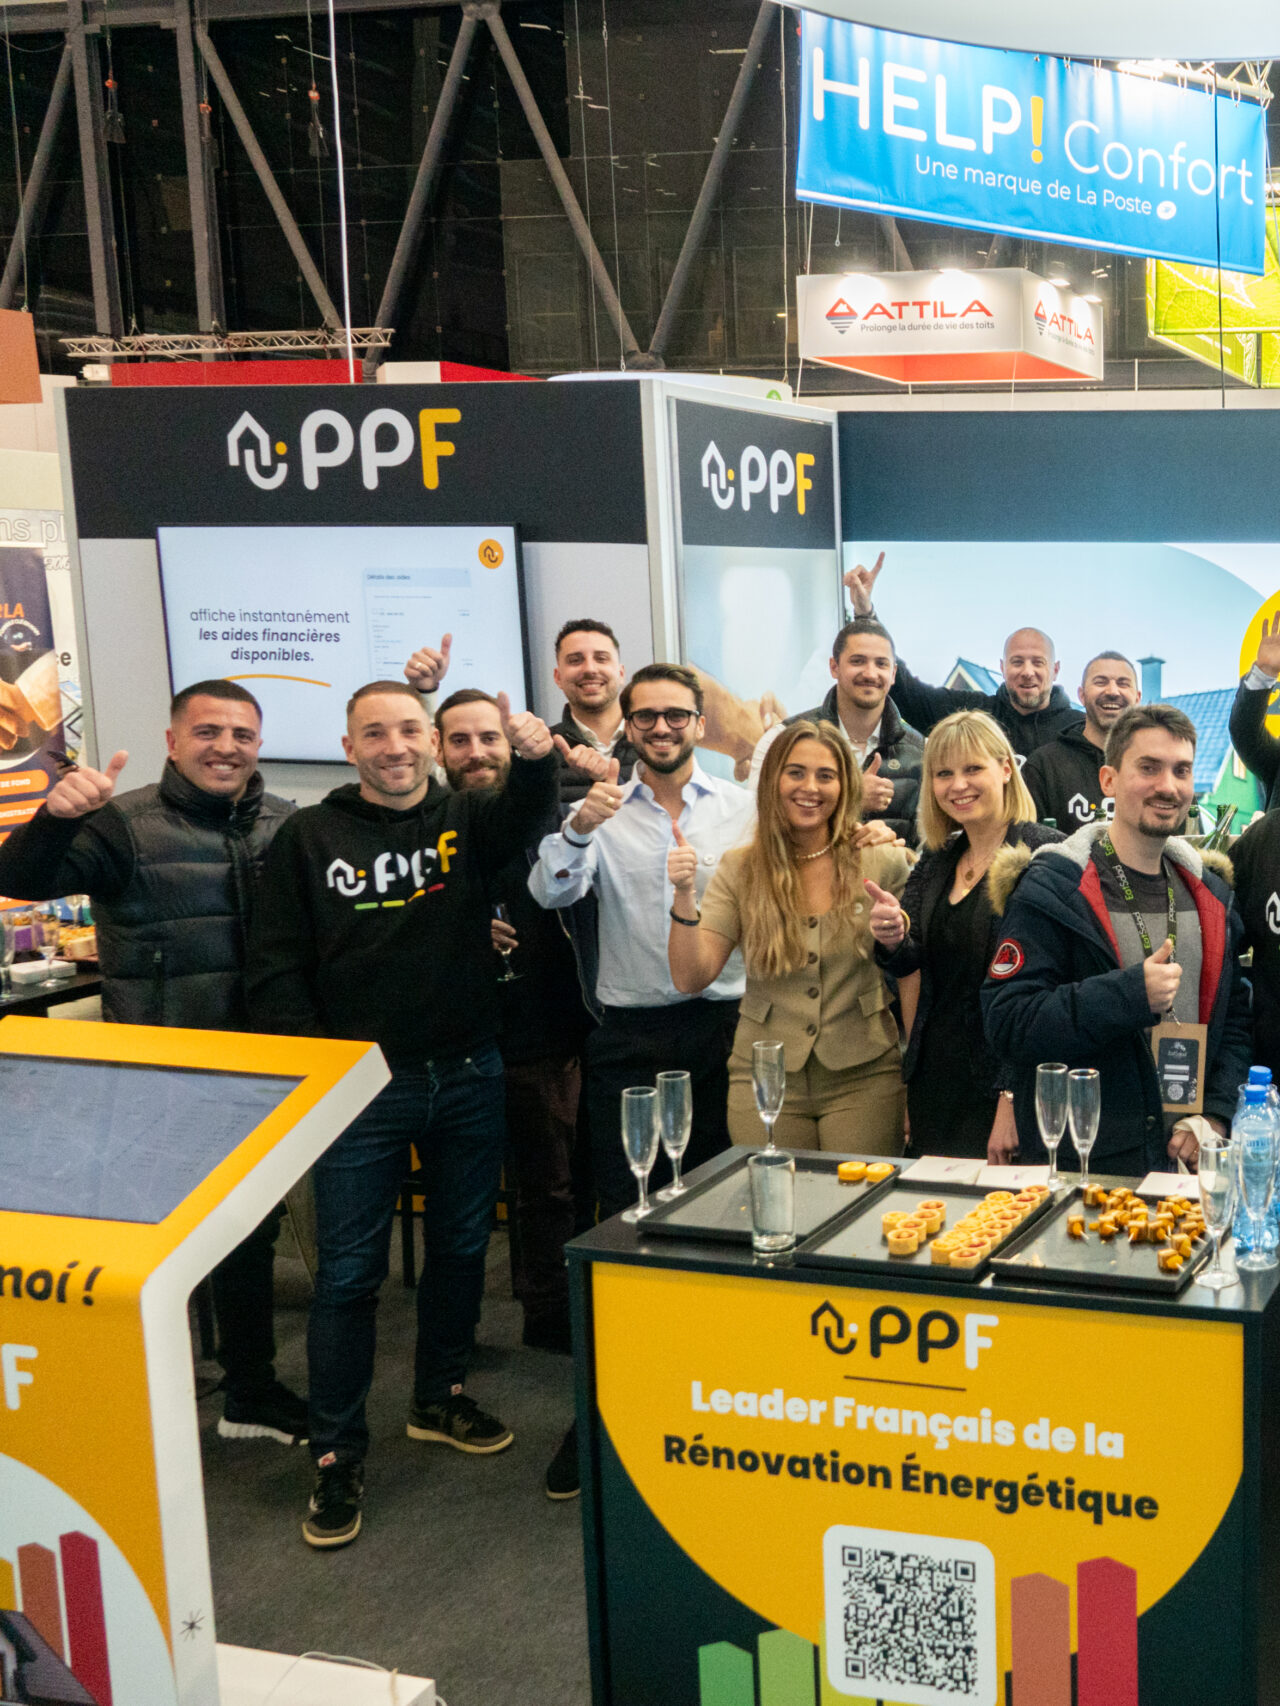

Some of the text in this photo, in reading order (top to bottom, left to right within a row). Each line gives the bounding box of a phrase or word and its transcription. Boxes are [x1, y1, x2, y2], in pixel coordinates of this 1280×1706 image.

[813, 47, 1254, 205] HELP! Confort
[916, 154, 1152, 215] Une marque de La Poste
[860, 320, 995, 333] Prolonge la durée de vie des toits
[862, 299, 994, 321] ATTILA
[1049, 312, 1094, 345] ATTILA
[300, 408, 462, 490] PPF
[740, 446, 815, 515] PPF
[0, 602, 24, 619] LA
[190, 608, 350, 624] affiche instantanément
[199, 627, 341, 643] les aides financières
[230, 647, 315, 664] disponibles.
[869, 1304, 999, 1371] PPF
[691, 1379, 1125, 1459] Leader Français de la
[663, 1433, 1160, 1526] Rénovation Énergétique
